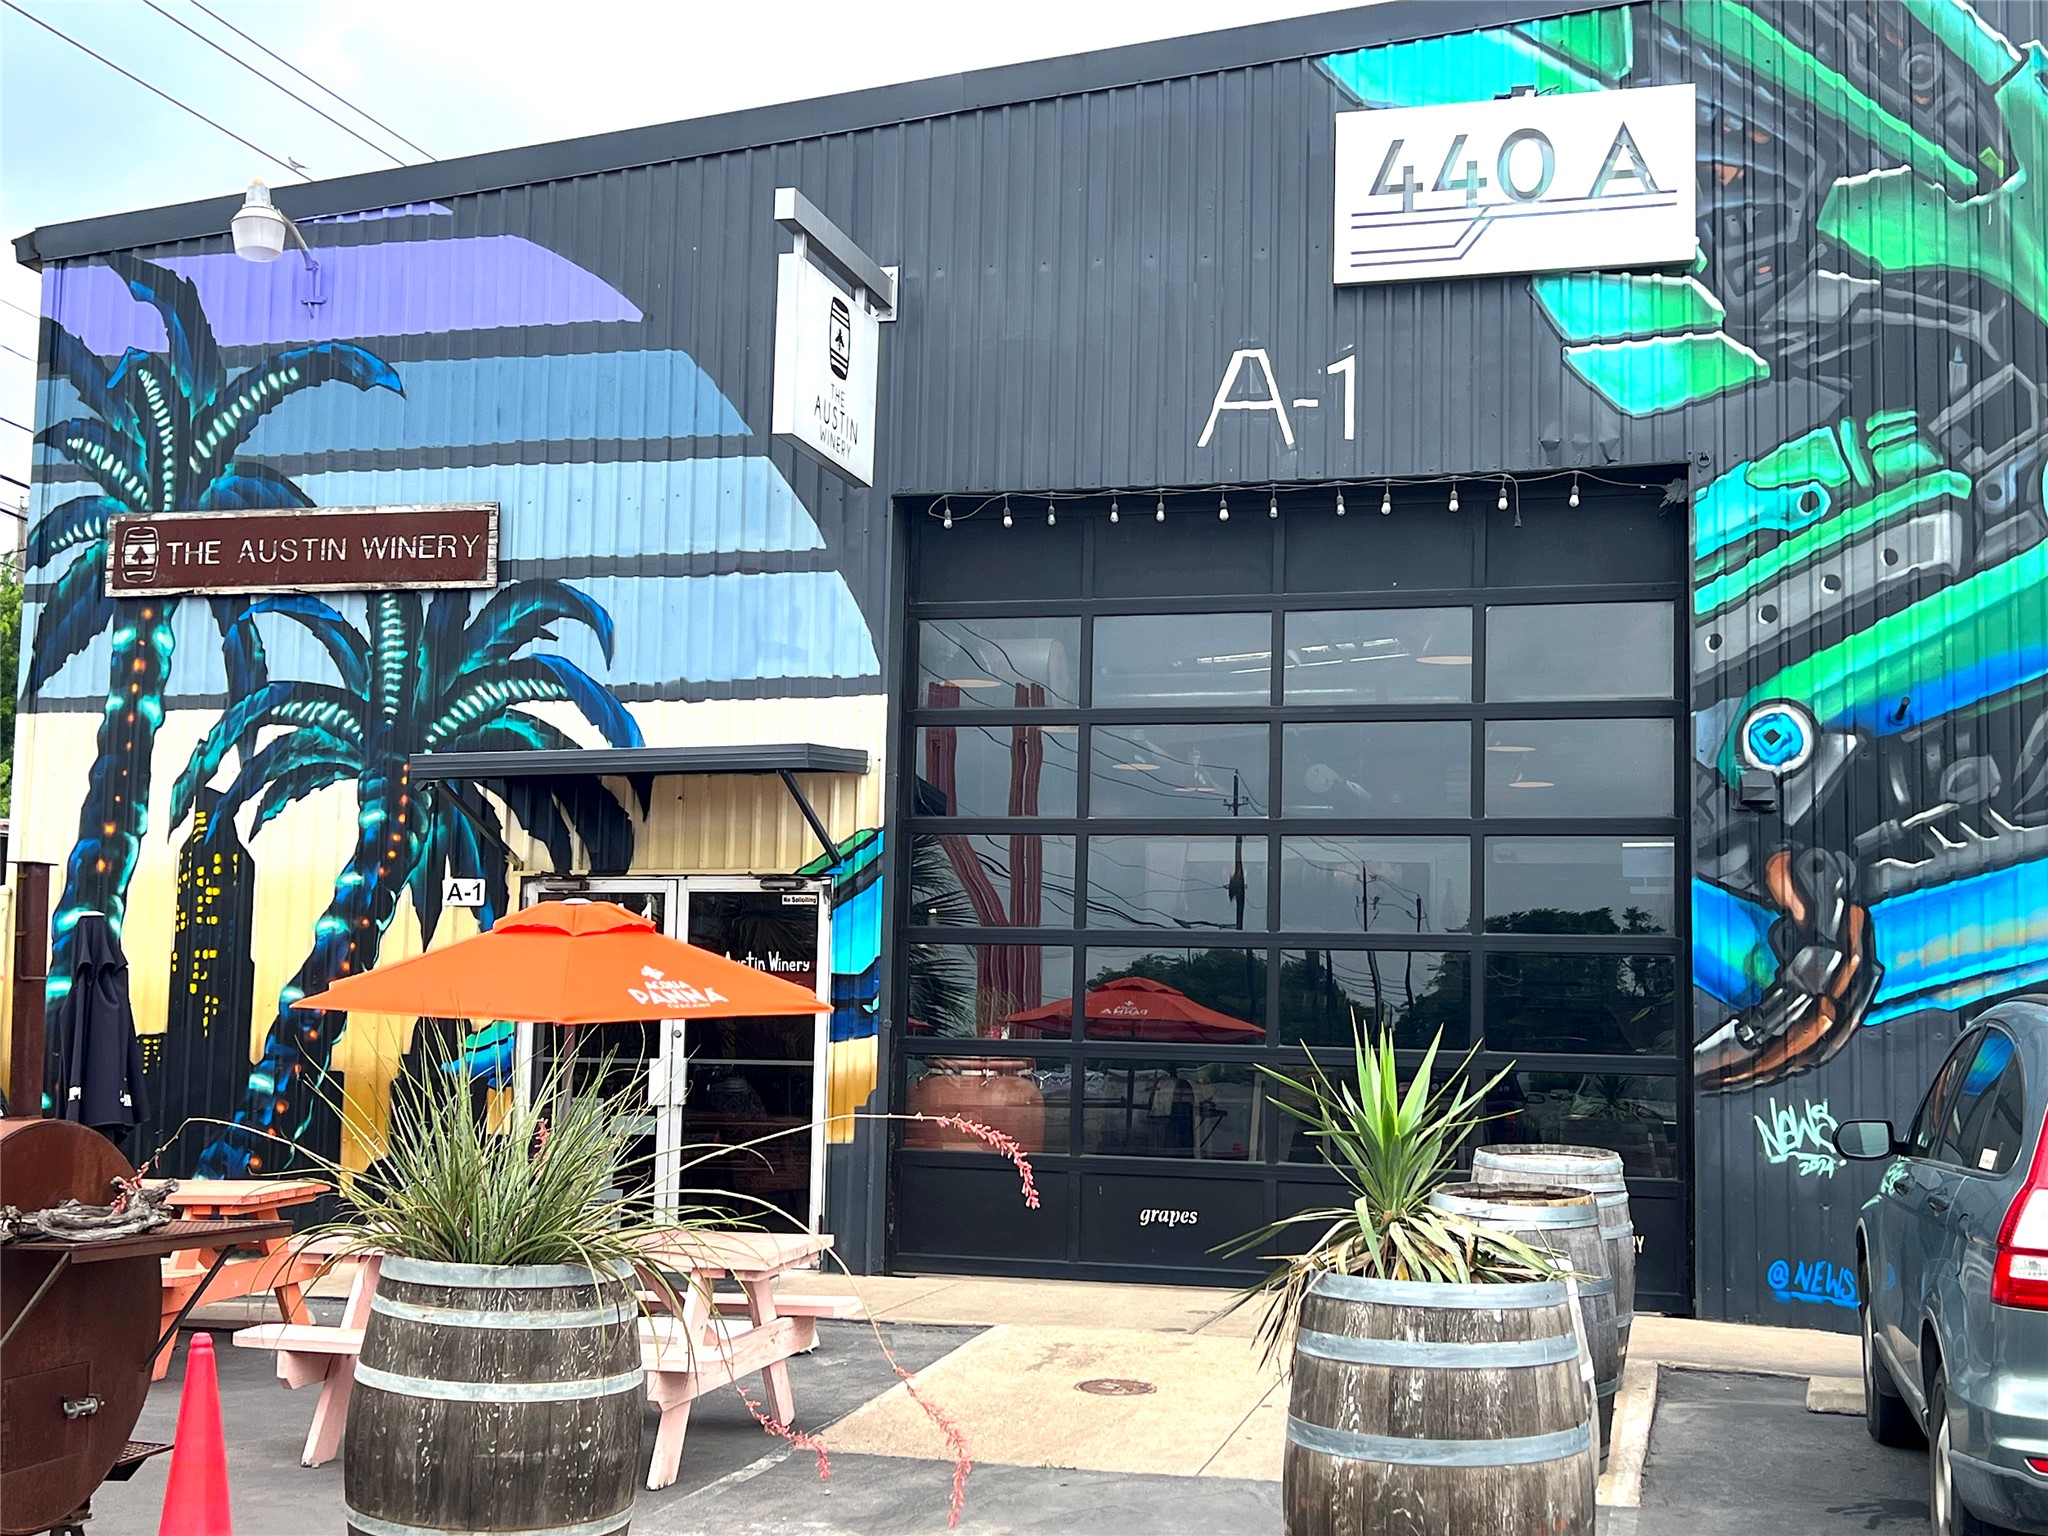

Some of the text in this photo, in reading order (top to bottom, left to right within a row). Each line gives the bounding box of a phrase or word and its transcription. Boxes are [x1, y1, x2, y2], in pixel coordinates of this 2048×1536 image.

[1368, 121, 1660, 212] 440 A
[831, 383, 845, 408] THE
[1197, 348, 1355, 447] A-1
[814, 394, 858, 445] AUSTIN
[820, 425, 851, 459] WINERY
[166, 533, 480, 565] THE AUSTIN WINERY
[447, 883, 481, 901] A-1
[725, 951, 810, 972] tin Winery
[627, 987, 729, 1004] PANNA
[644, 980, 691, 990] ACQUA
[1140, 1209, 1198, 1227] grapes
